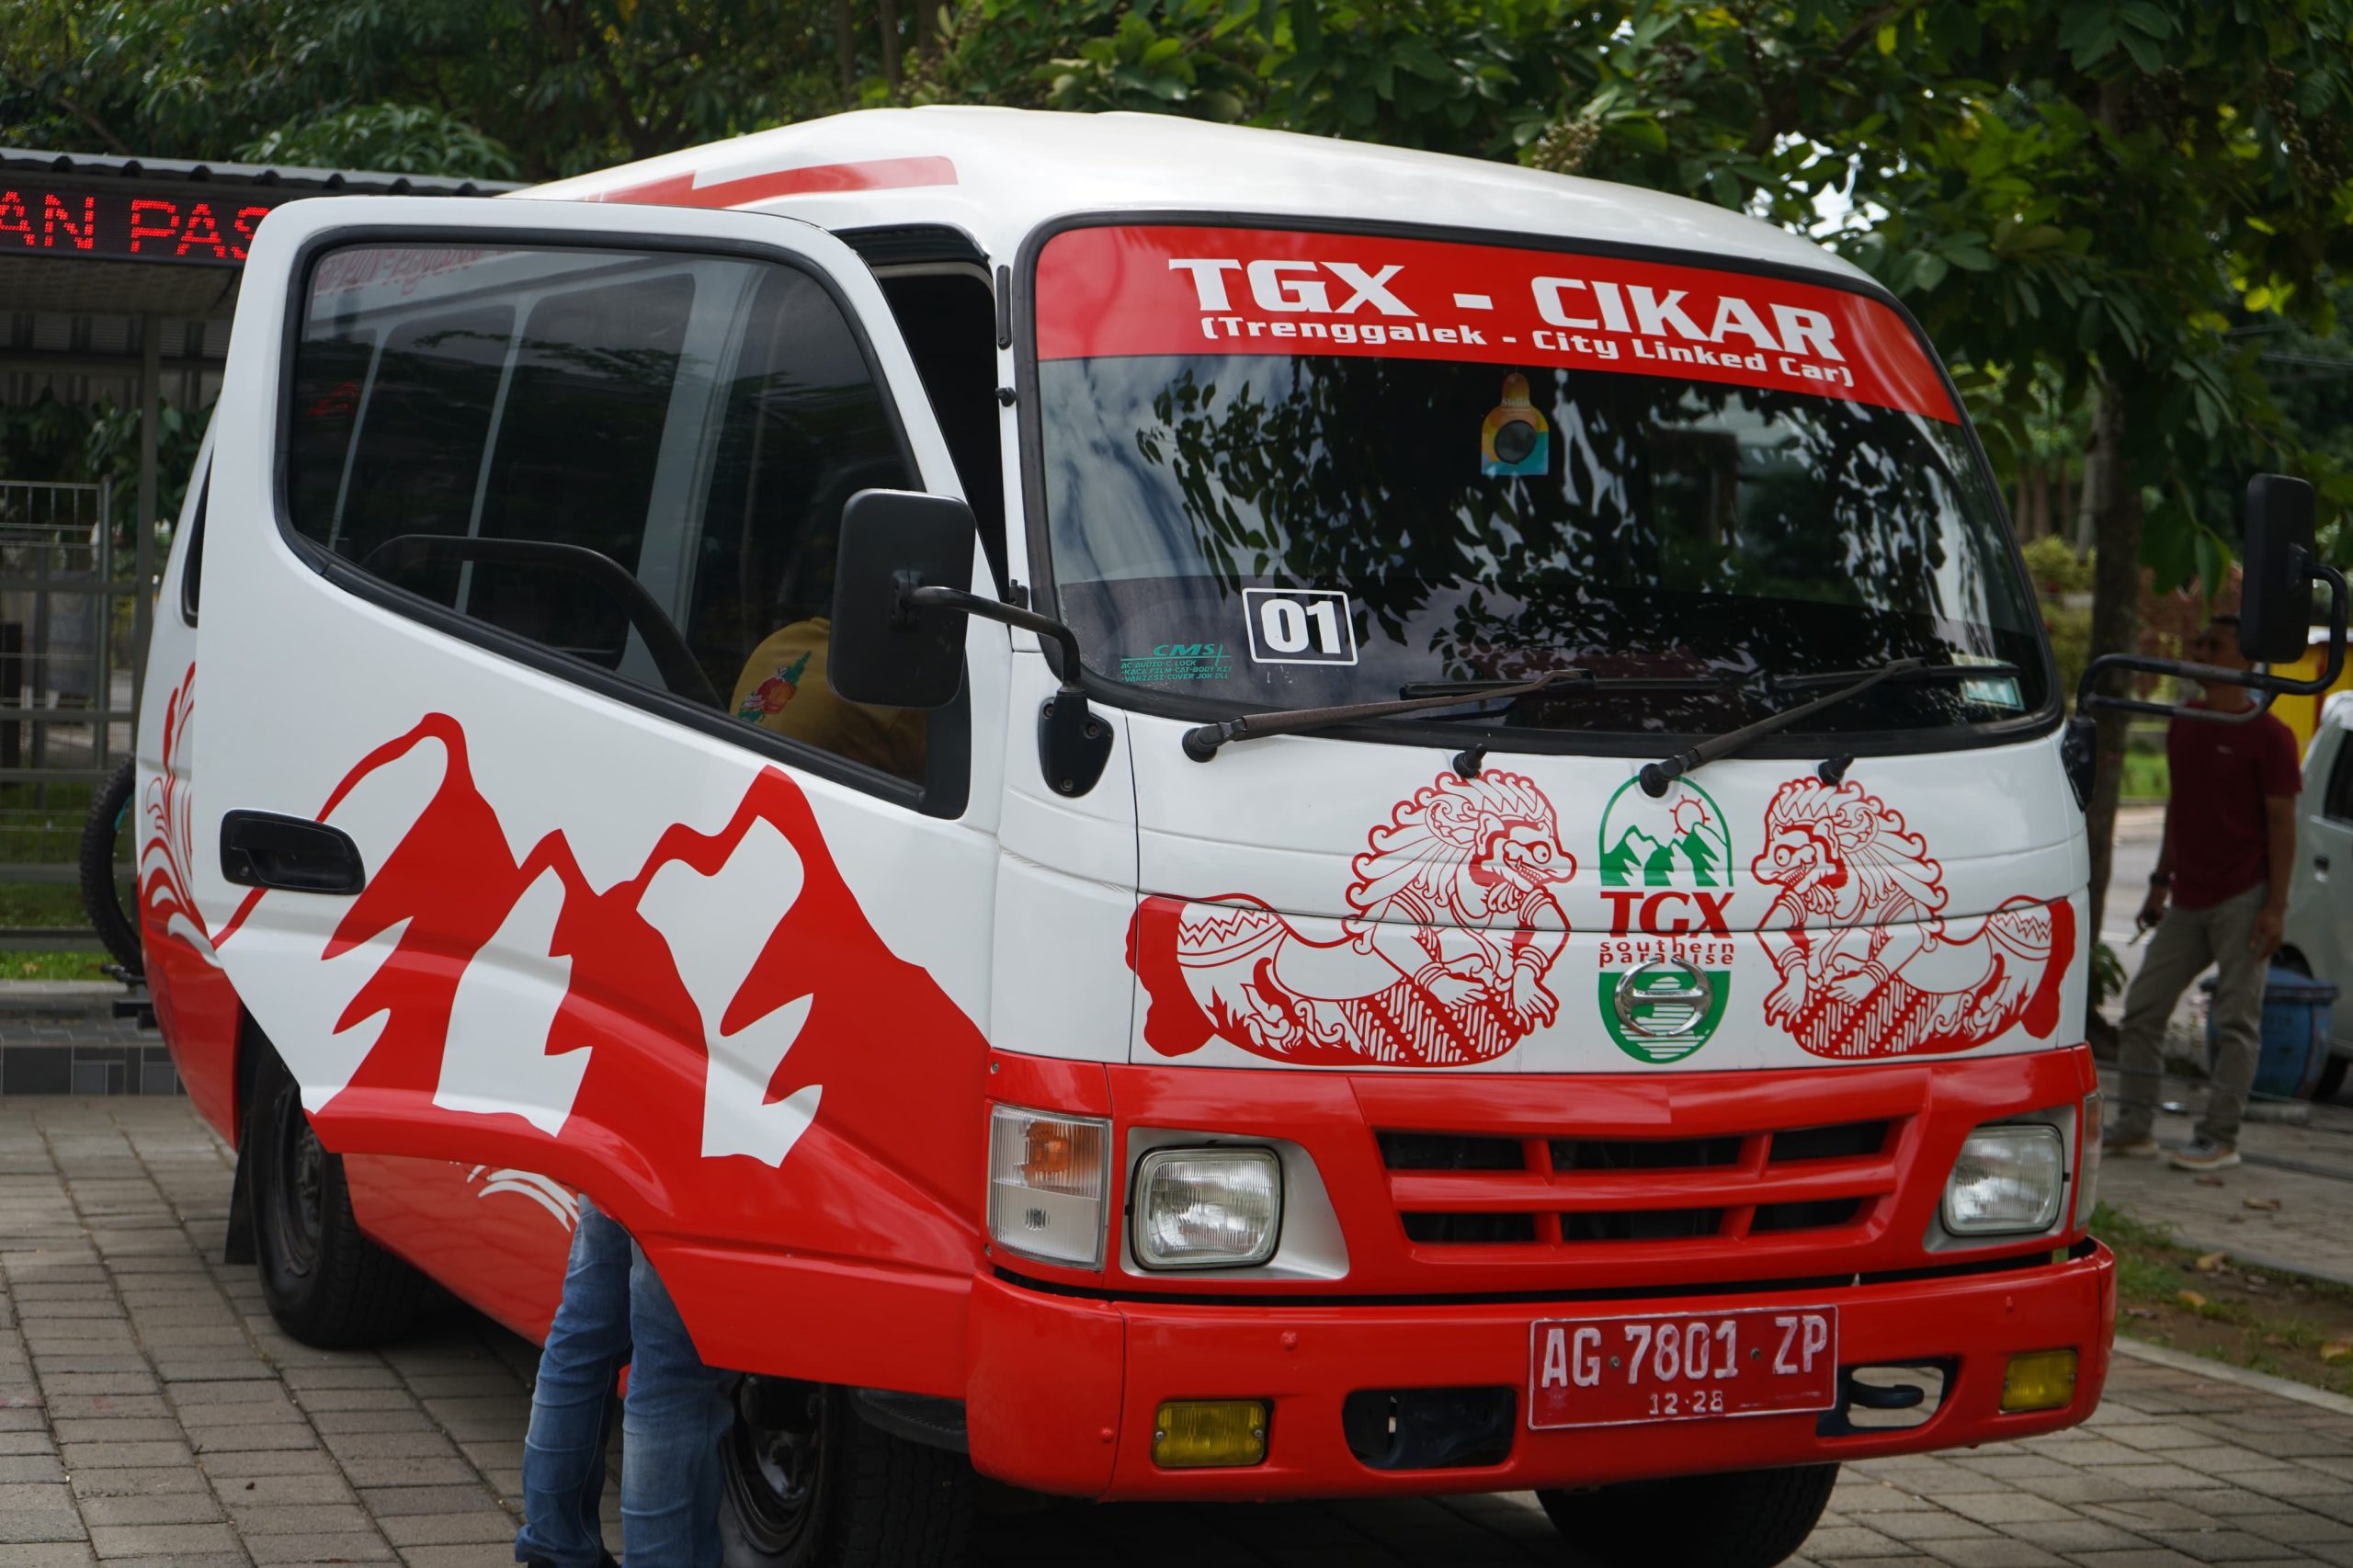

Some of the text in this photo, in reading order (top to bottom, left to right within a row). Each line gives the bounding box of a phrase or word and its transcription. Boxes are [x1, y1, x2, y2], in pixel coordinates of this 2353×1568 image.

[0, 190, 95, 250] AN
[1168, 258, 1847, 362] TGX - CIKAR
[1200, 316, 1488, 346] (Trenggalek
[1531, 330, 1620, 360] City
[1631, 338, 1768, 372] Linked
[1778, 357, 1855, 388] Car)
[1153, 643, 1216, 656] CMS
[1260, 598, 1341, 653] 01
[1600, 891, 1735, 939] TGX
[1599, 952, 1733, 968] paradise
[1600, 938, 1734, 953] southern
[1541, 1314, 1827, 1388] AG 7801 ZP
